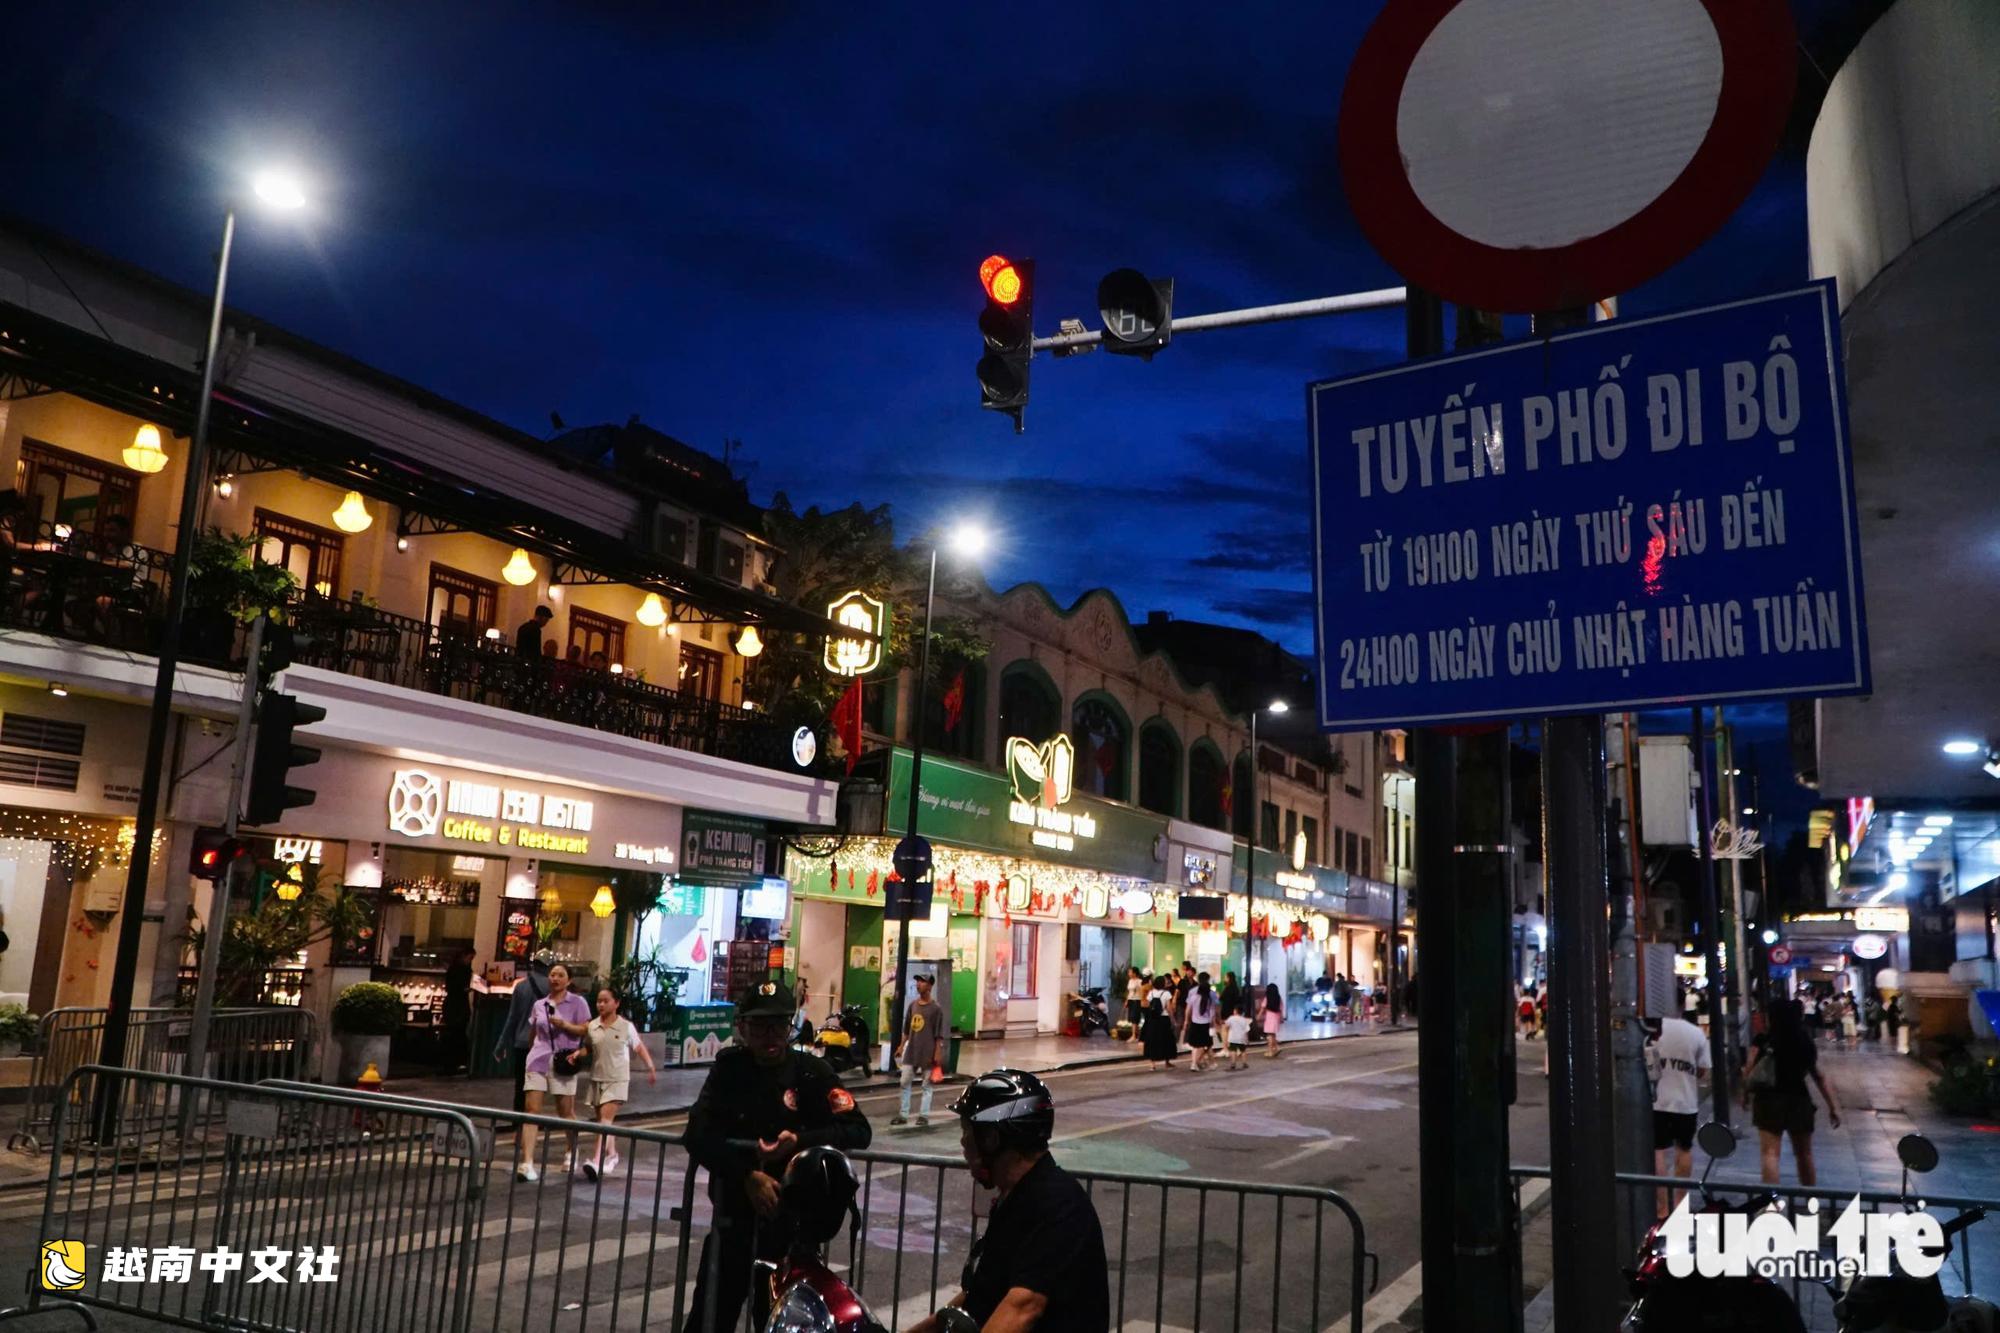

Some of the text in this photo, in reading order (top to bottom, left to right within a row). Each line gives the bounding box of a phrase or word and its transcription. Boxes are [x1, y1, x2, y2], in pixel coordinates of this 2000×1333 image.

[1351, 334, 1802, 498] TUYẾN PHỐ ĐI BỘ
[1360, 475, 1786, 592] TỪ 19H00 NGÀY THỨ SÁU ĐẾN
[1340, 577, 1842, 691] 24H00 NGÀY CHỦ NHẬT HÀNG TUẦN
[443, 819, 590, 855] Coffee & Restaurant
[707, 829, 733, 851] KEM
